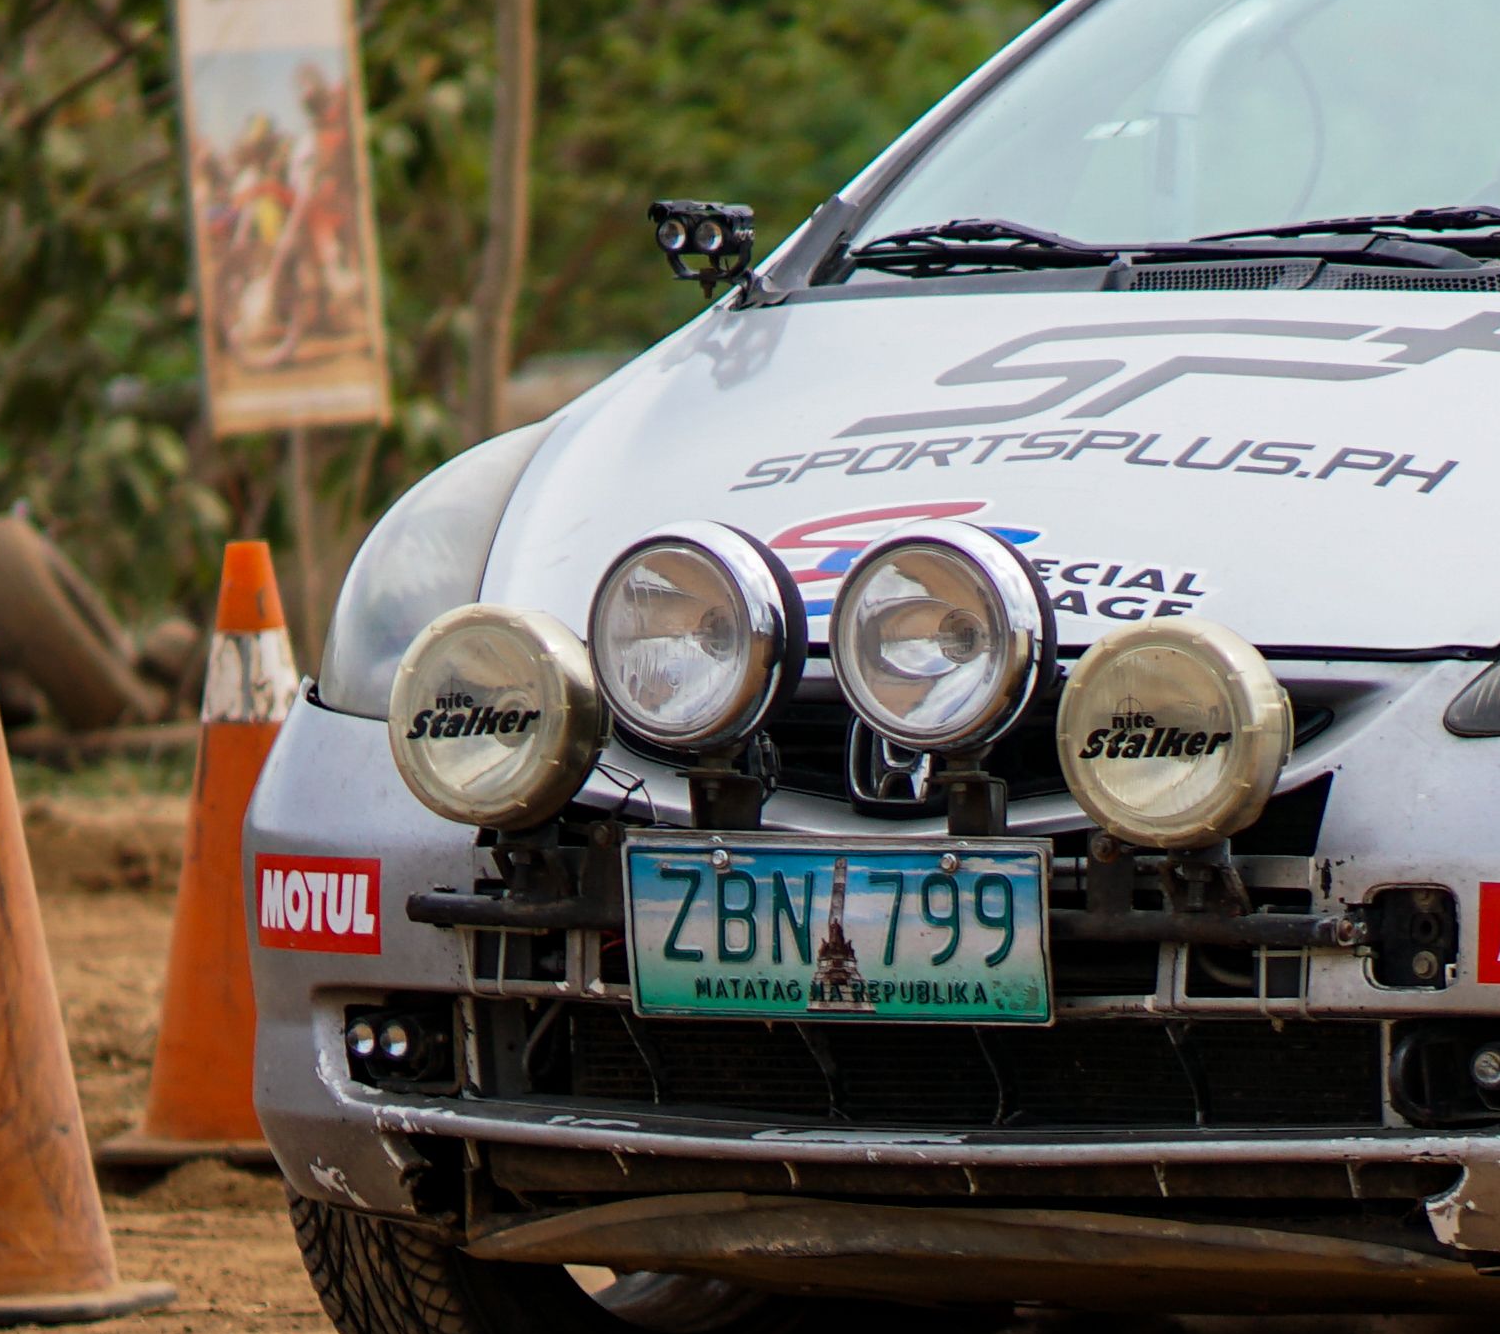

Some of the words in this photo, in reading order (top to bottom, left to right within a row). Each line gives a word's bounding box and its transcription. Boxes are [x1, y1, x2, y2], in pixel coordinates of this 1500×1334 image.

[729, 429, 1459, 495] SPORTSPLUS.PH
[435, 691, 474, 710] nite
[1112, 712, 1156, 729] nite
[261, 868, 376, 935] MOTUL
[658, 868, 816, 964] ZBN
[867, 870, 1015, 968] 799
[695, 977, 802, 1003] MATATAG
[851, 978, 990, 1005] REPUBLIKA
